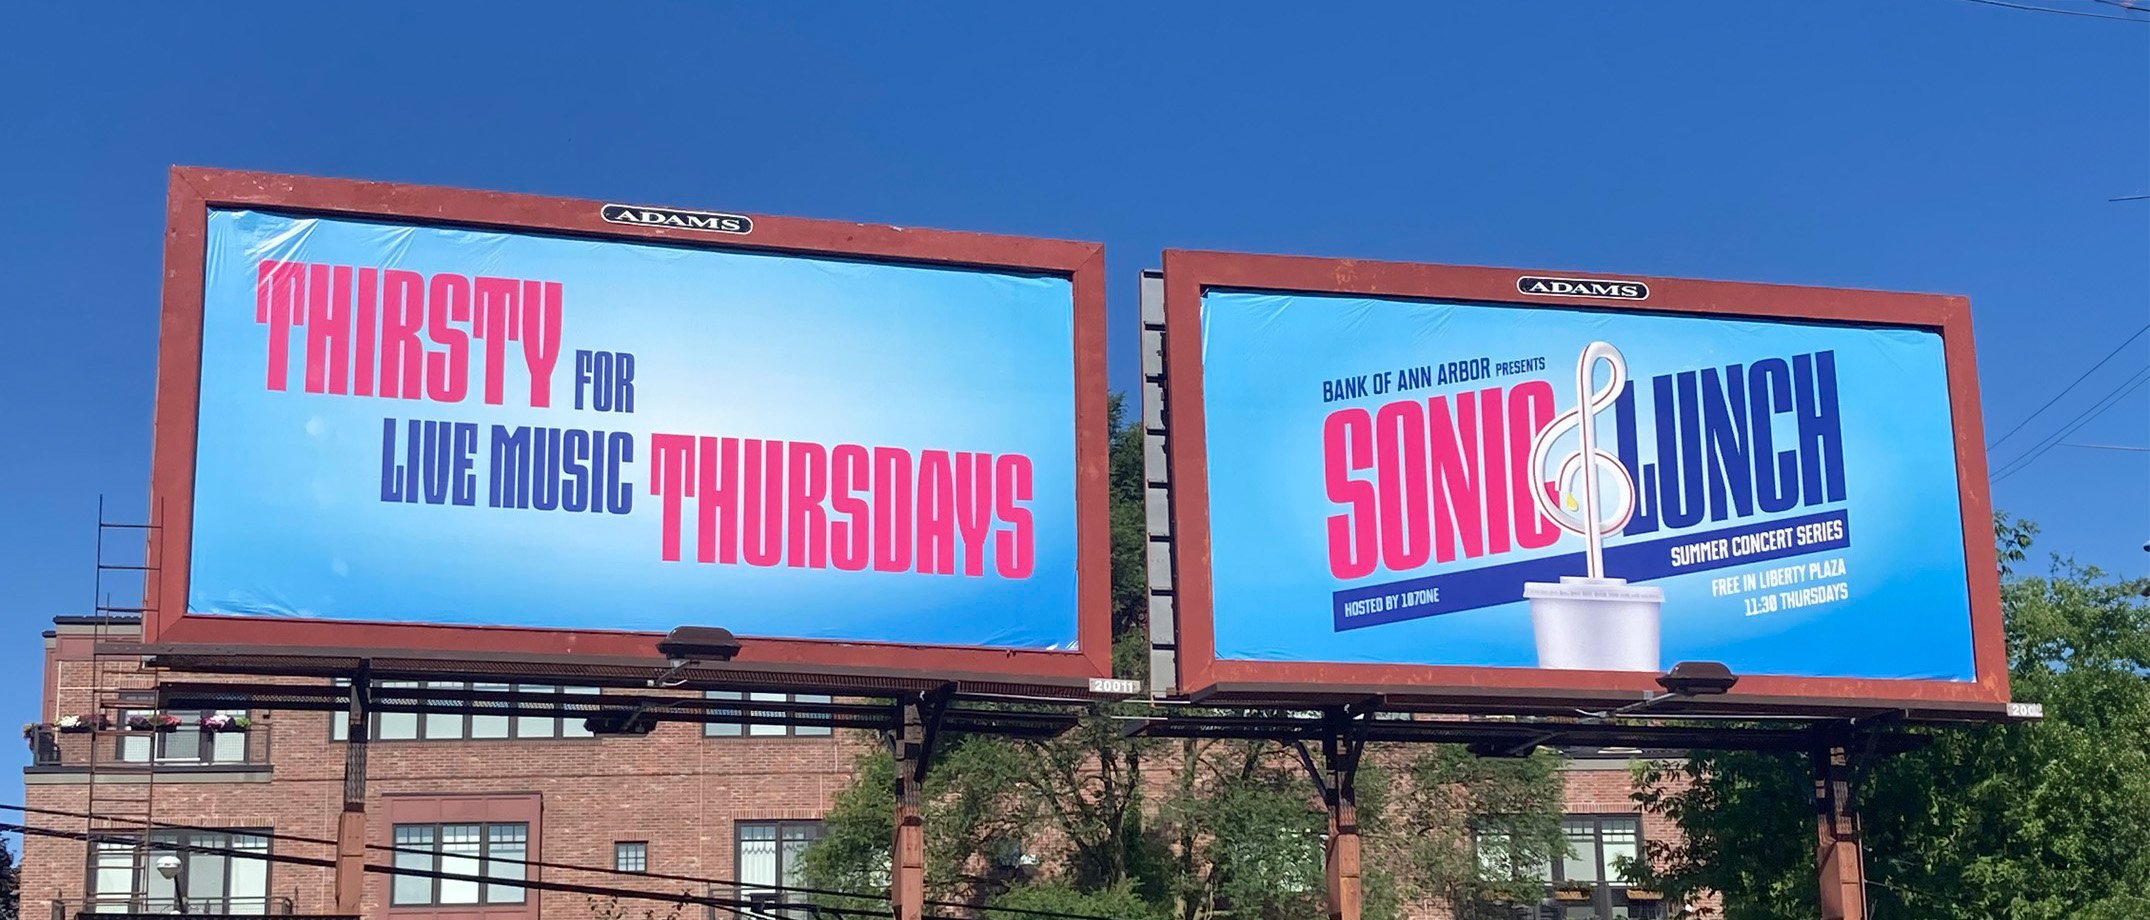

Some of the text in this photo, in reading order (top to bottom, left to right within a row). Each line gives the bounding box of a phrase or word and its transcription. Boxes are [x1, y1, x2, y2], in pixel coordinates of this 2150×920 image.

[615, 210, 741, 231] ADAMS
[1529, 281, 1638, 297] ADAMS
[256, 260, 635, 413] THIRSTY FOR
[1323, 357, 1546, 402] BANK OF ANN ARBOR PRESENTS
[1324, 349, 1847, 580] SONIC LUNCH
[380, 417, 1034, 579] LIVE MUSIC THURSDAYS
[1671, 519, 1843, 567] SUMMER CONCERT SERIES
[1712, 558, 1847, 597] FREE IN LIBERTY PLAZA
[1344, 597, 1384, 618] HOSTED
[1385, 594, 1400, 611] BY
[1744, 582, 1849, 616] 11:30 THURSDAYS
[1095, 681, 1133, 693] 20011
